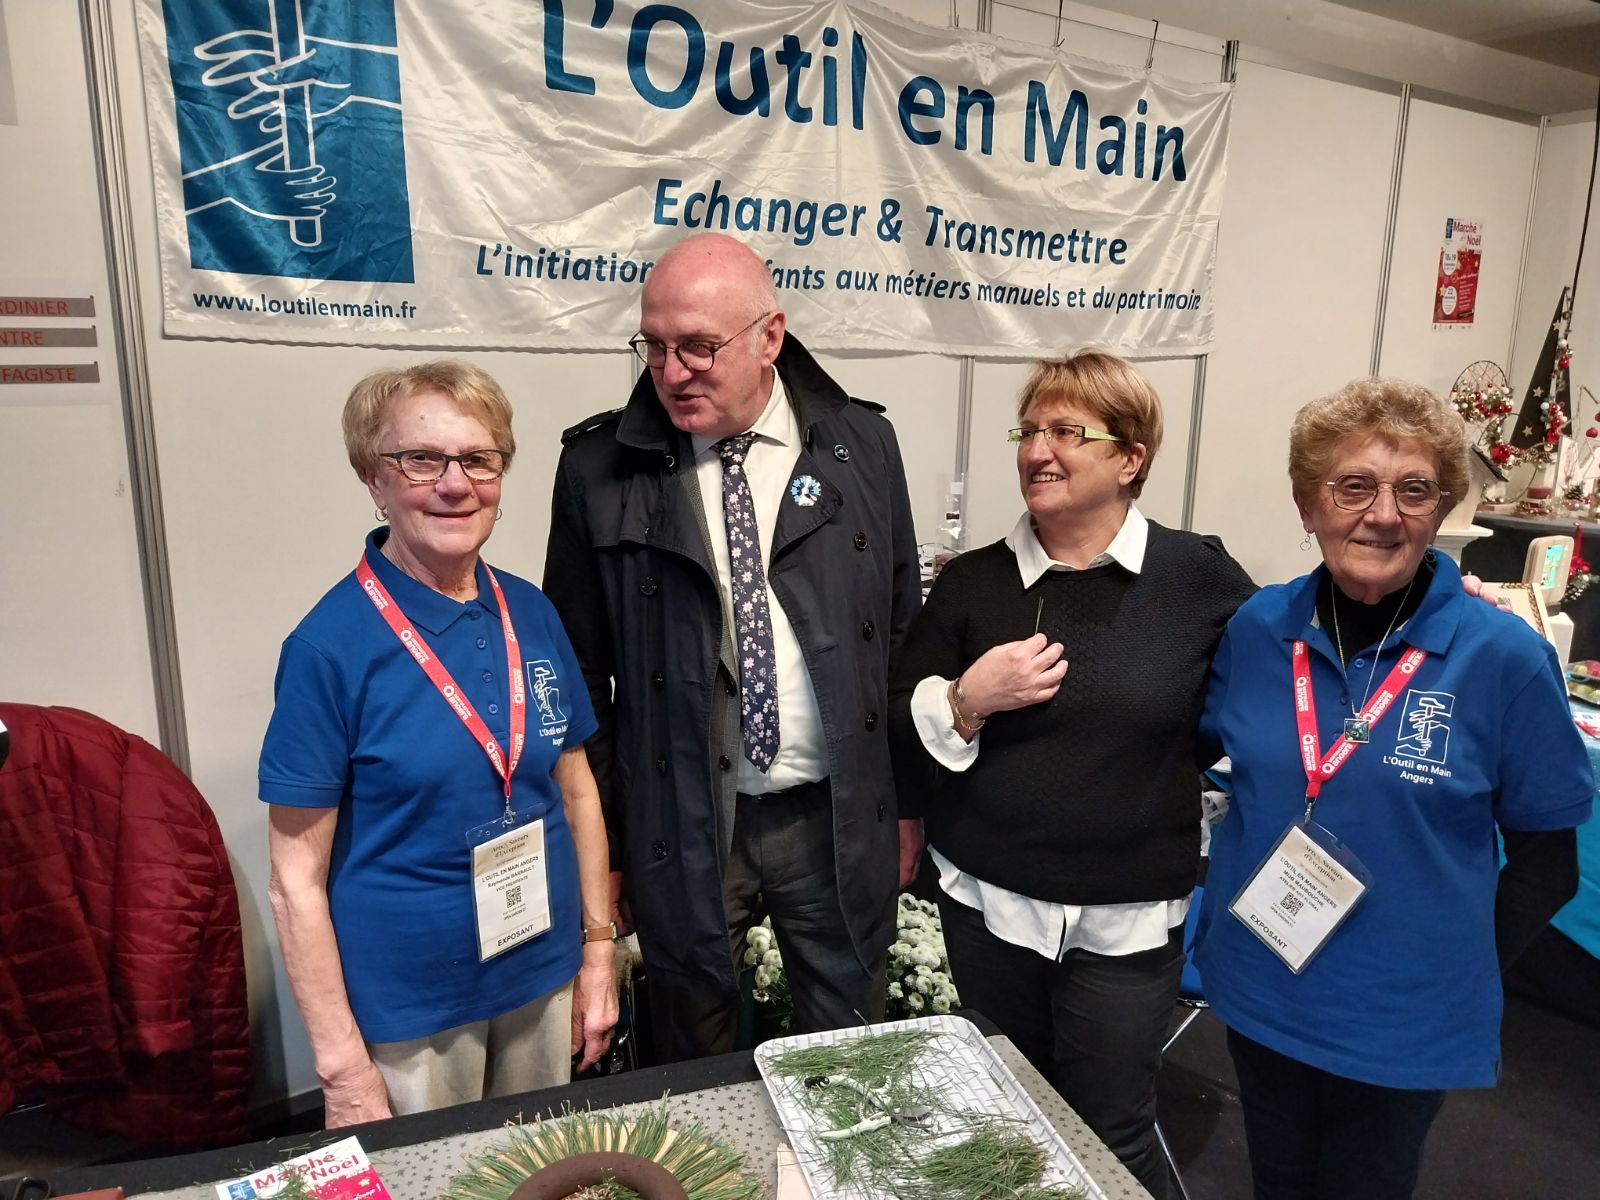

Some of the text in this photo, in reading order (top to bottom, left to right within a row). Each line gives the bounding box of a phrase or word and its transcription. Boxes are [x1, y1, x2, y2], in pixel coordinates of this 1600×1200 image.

[543, 0, 1188, 182] L'Outil en Main
[653, 177, 1129, 265] Echanger & Transmettre
[1453, 221, 1477, 234] Marché
[835, 266, 878, 292] aux
[885, 269, 971, 301] métiers
[977, 282, 1060, 307] manuels
[1067, 287, 1087, 308] et
[1092, 285, 1116, 309] du
[193, 293, 417, 319] www.loutilenmain.fr
[1383, 755, 1452, 778] L'Outil en Main
[1400, 770, 1434, 785] Angers
[520, 855, 539, 867] ANGERS
[1280, 857, 1297, 875] L'OUTIL
[1296, 872, 1305, 881] EN
[1304, 878, 1318, 891] MAIN
[1317, 889, 1337, 908] ANGERS
[497, 923, 535, 947] EXPOSANT
[1250, 914, 1288, 949] EXPOSANT
